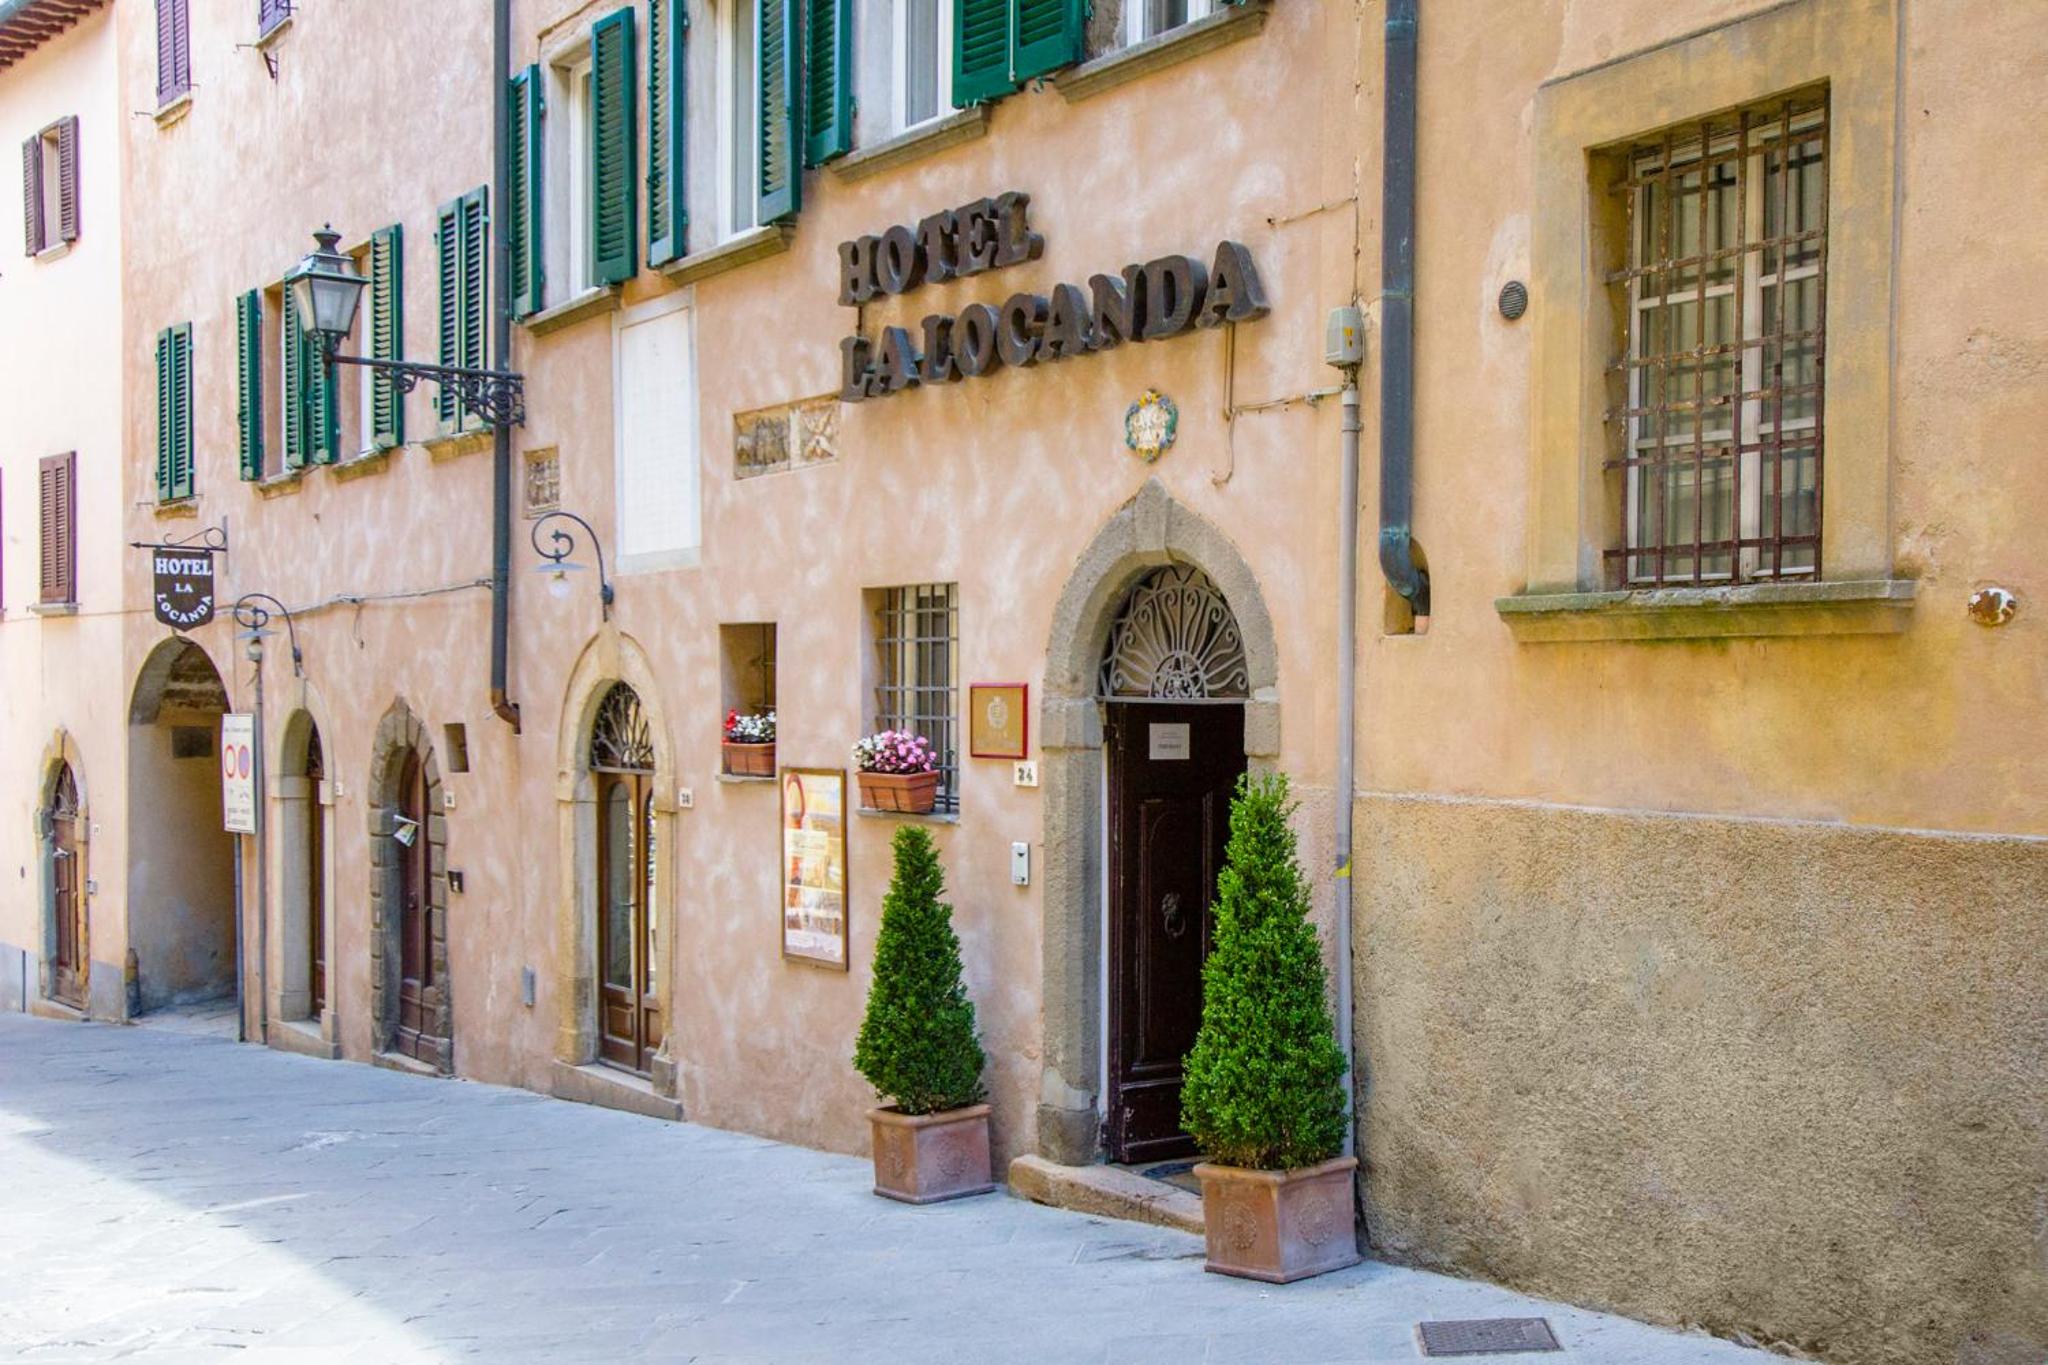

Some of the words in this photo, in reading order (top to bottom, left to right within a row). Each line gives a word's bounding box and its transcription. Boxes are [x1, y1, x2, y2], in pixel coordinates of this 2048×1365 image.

[838, 191, 1044, 306] HOTEL
[839, 326, 921, 403] LA
[921, 240, 1271, 386] LOCANDA
[155, 557, 212, 576] HOTEL
[174, 582, 193, 593] LA
[156, 593, 212, 623] LOCANDA
